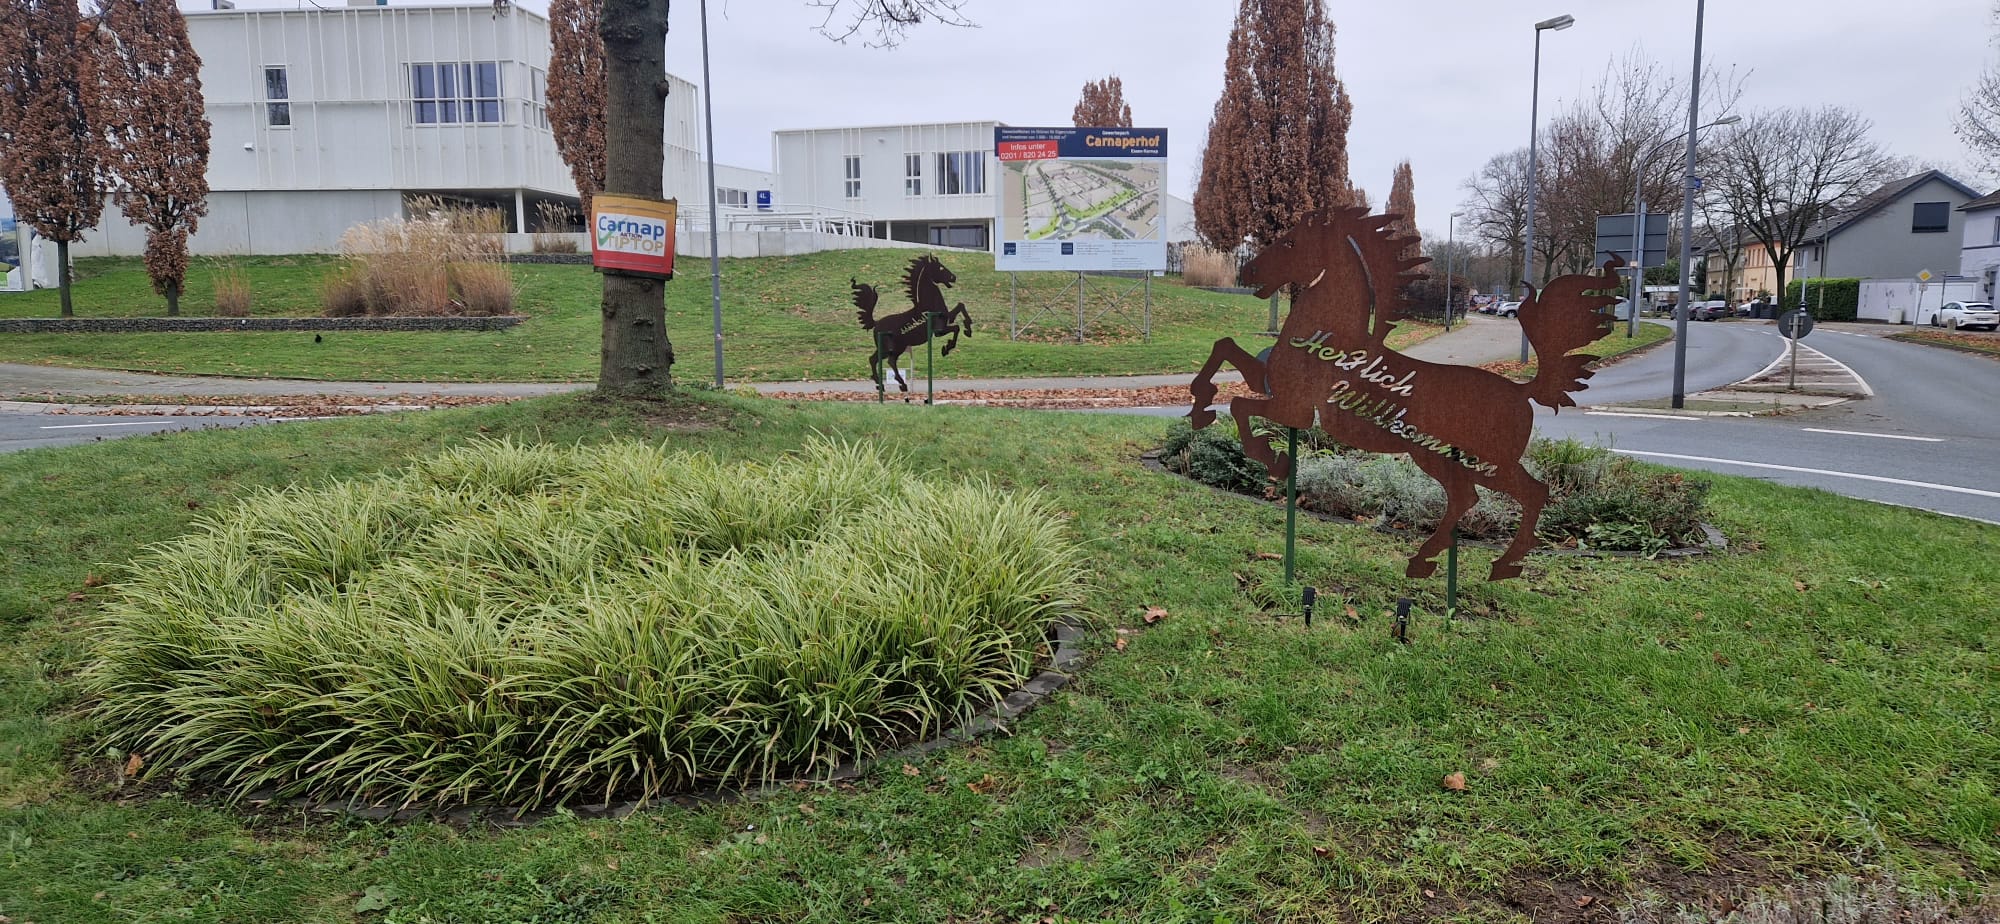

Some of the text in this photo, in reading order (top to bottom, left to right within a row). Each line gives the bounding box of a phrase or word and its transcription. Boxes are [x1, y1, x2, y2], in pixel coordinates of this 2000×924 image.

[1010, 143, 1027, 151] Infos
[1085, 135, 1160, 150] Carnaperhof
[1047, 150, 1057, 158] 25
[598, 215, 665, 241] Carnap
[1290, 330, 1416, 396] Herzlich
[1326, 380, 1499, 478] Willkommen
